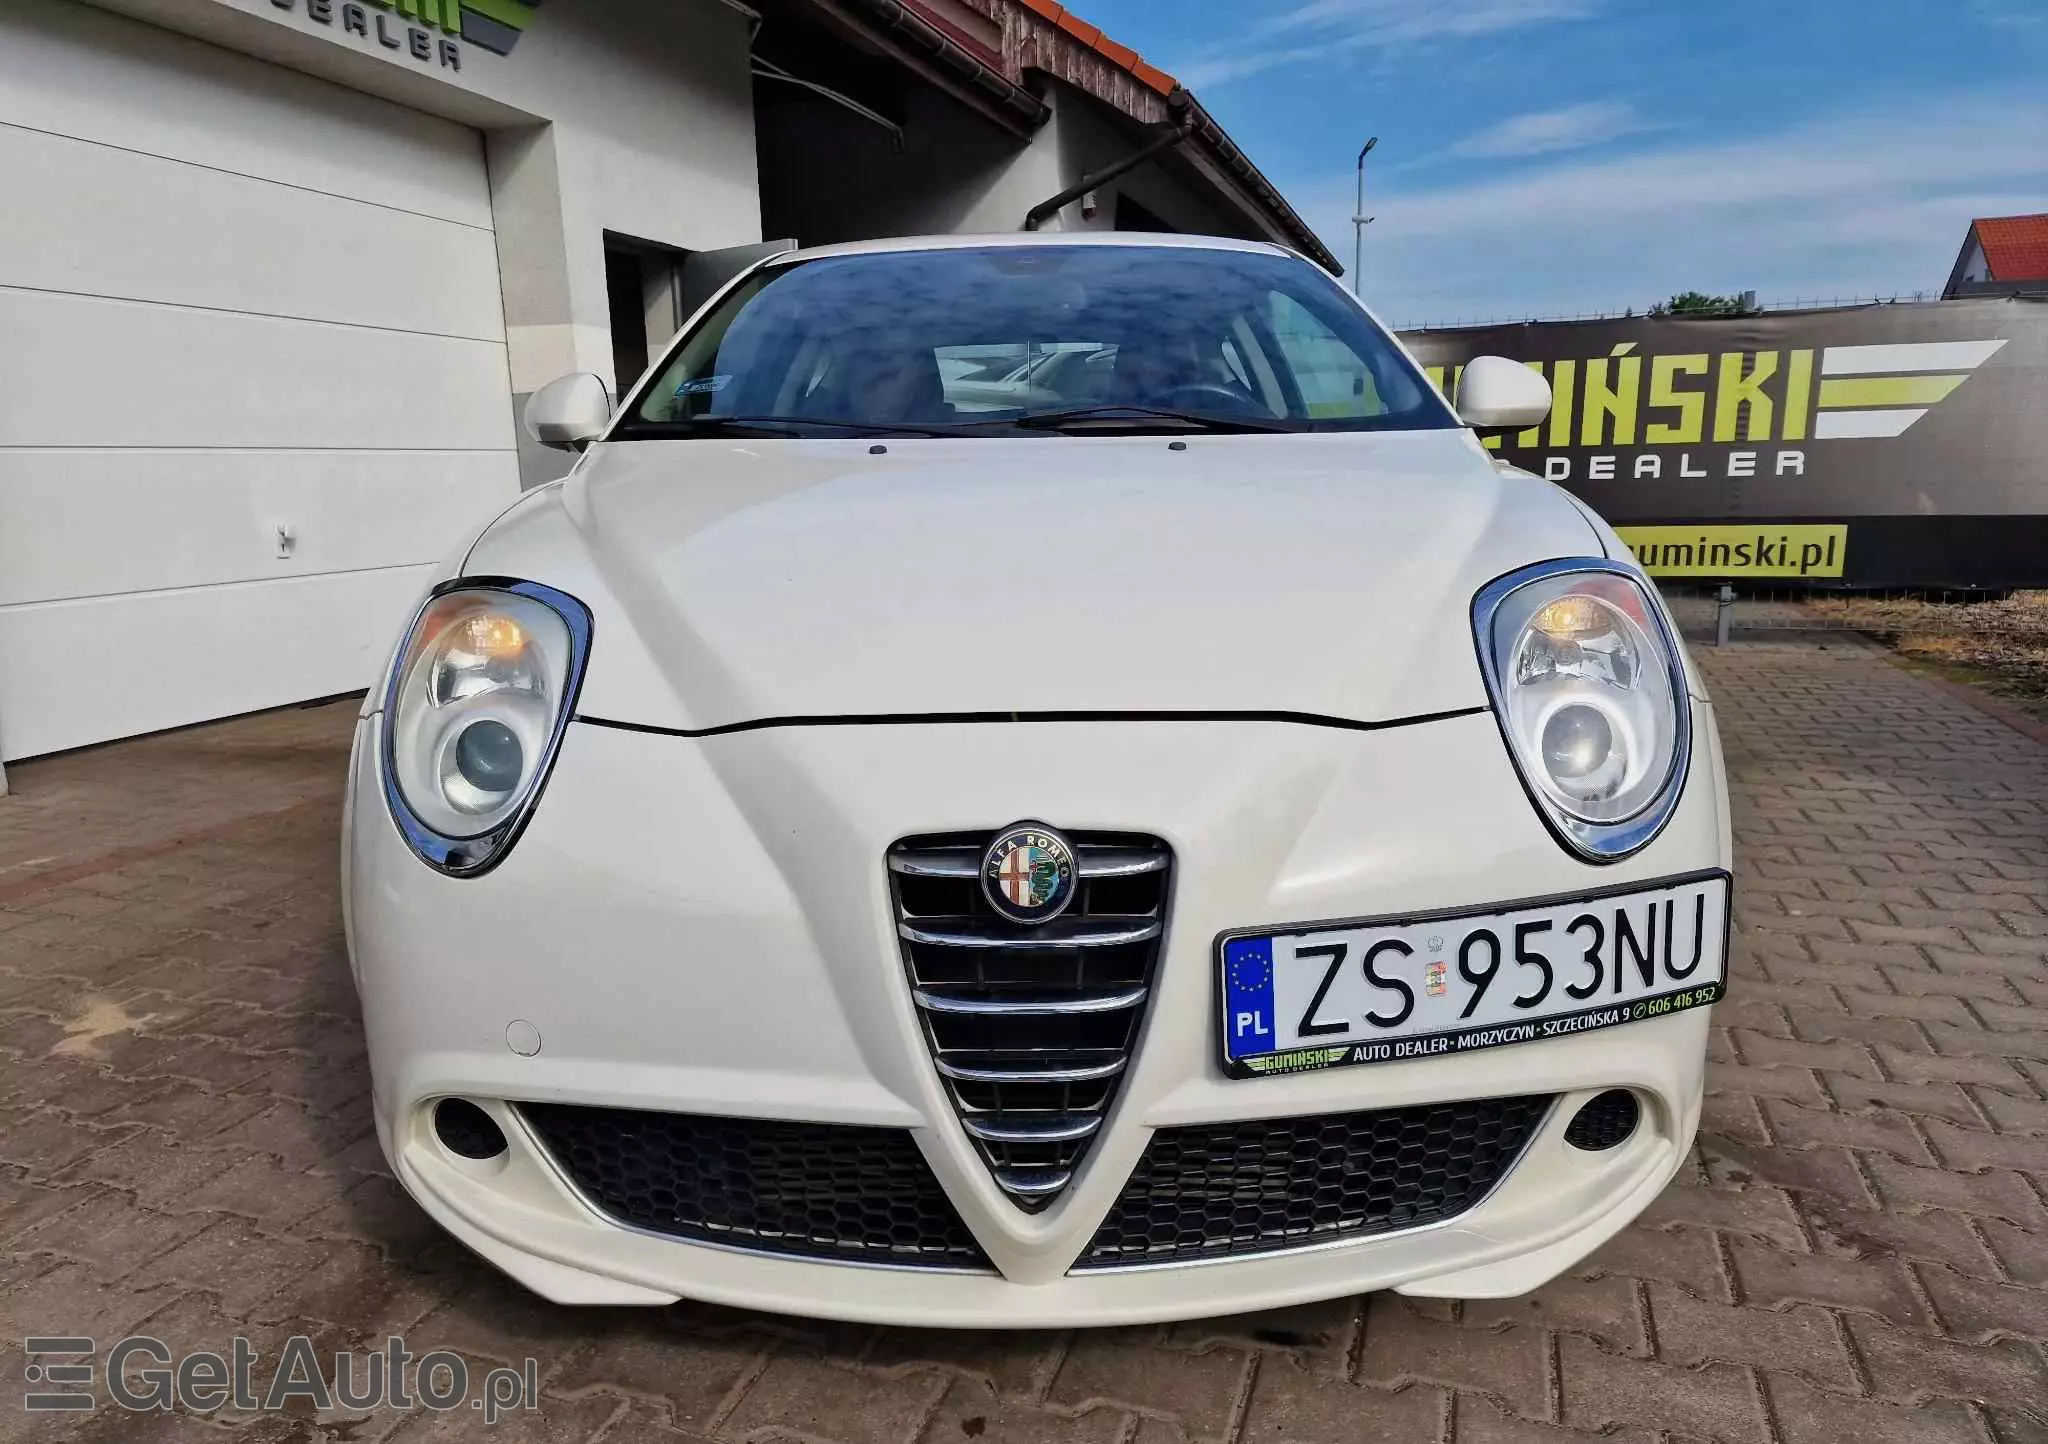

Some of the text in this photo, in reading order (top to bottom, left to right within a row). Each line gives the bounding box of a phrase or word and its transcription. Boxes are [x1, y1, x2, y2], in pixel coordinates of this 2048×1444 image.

[1544, 450, 1806, 482] DEALER
[1629, 535, 1836, 575] uminski.pl
[988, 835, 1070, 878] ALFA ROMEO
[1294, 893, 1705, 1037] ZS 953NU
[1236, 1011, 1269, 1037] PL
[1353, 1044, 1391, 1062] AUTO
[1648, 999, 1671, 1016] 606
[1674, 993, 1693, 1009] 416
[1695, 986, 1717, 1003] 952
